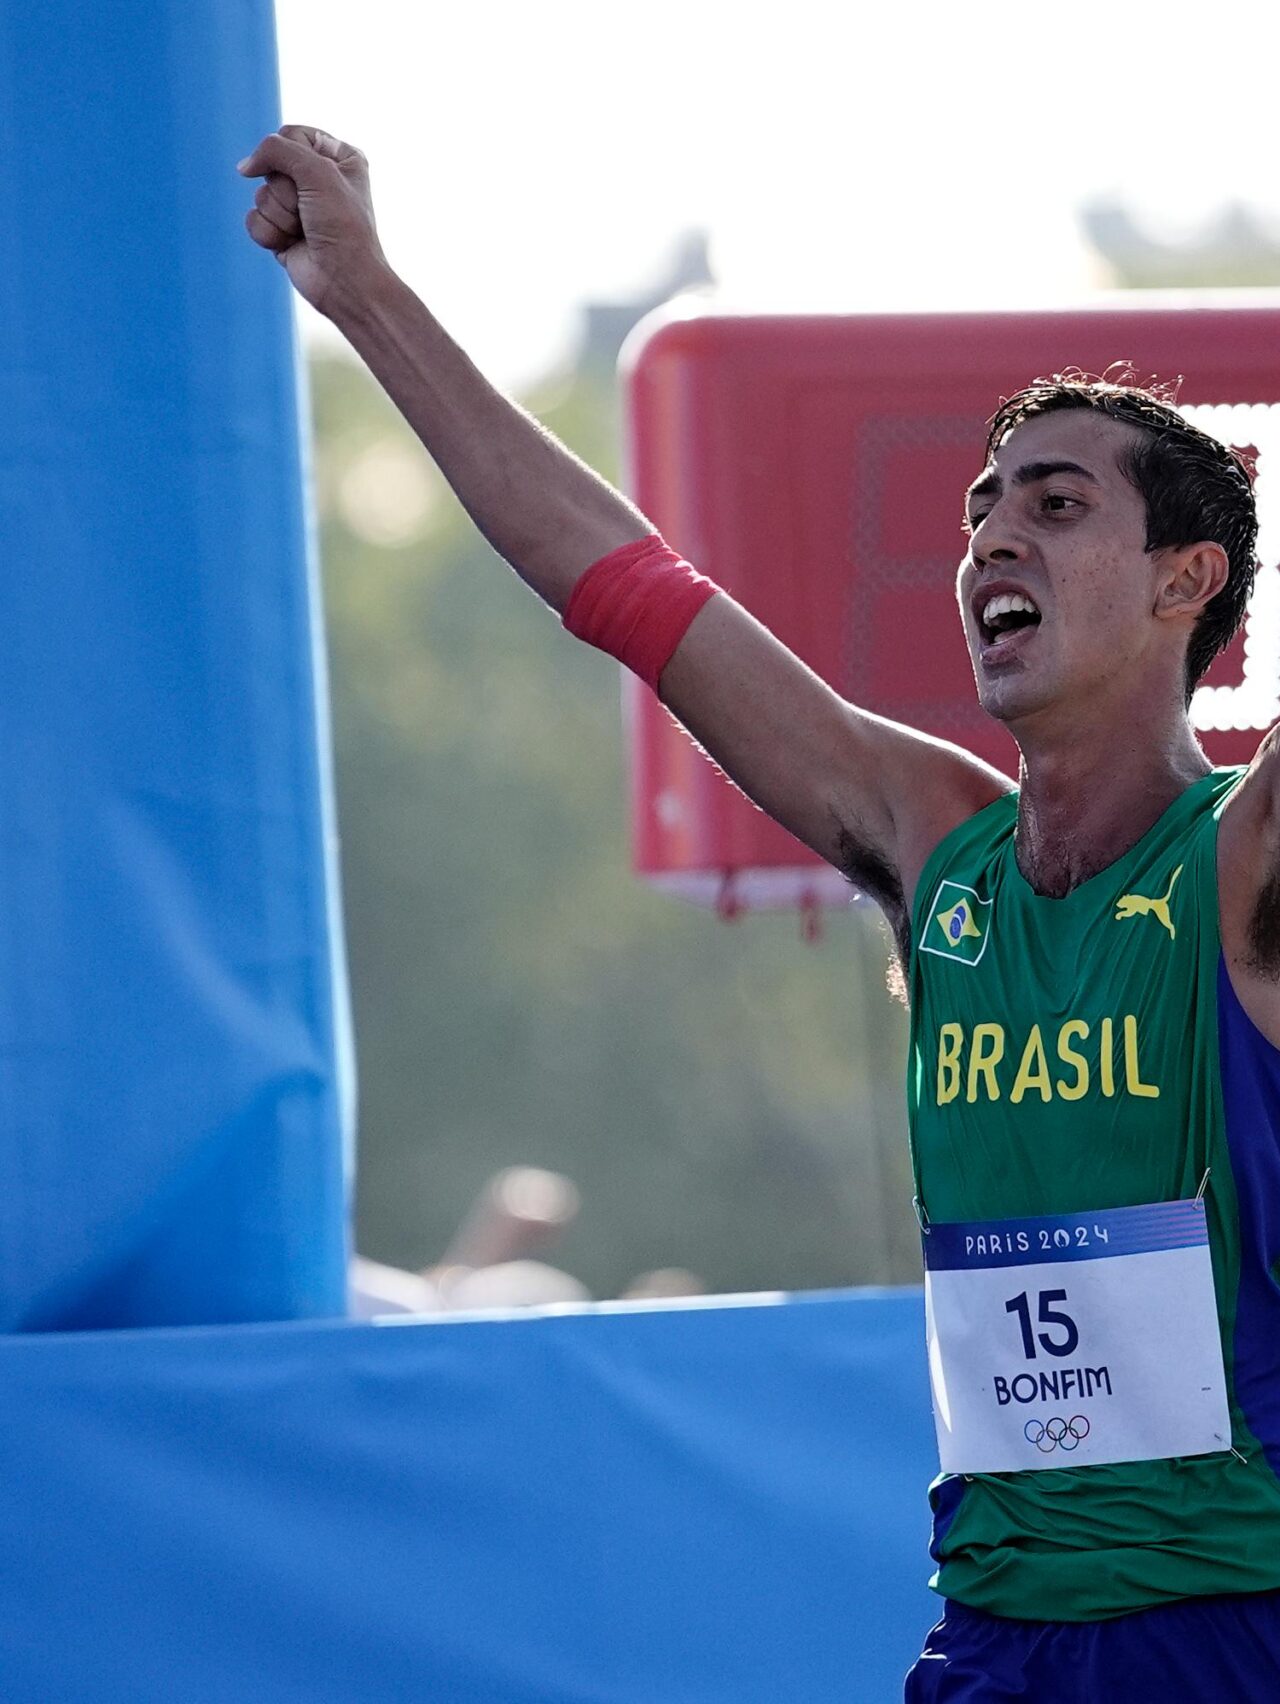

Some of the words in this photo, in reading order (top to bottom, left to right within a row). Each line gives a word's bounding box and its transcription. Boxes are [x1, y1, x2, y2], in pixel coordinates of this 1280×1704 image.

[937, 1015, 1160, 1106] BRASIL
[1039, 1224, 1110, 1249] 2024
[1005, 1289, 1079, 1360] 15
[993, 1366, 1112, 1406] BONFIM
